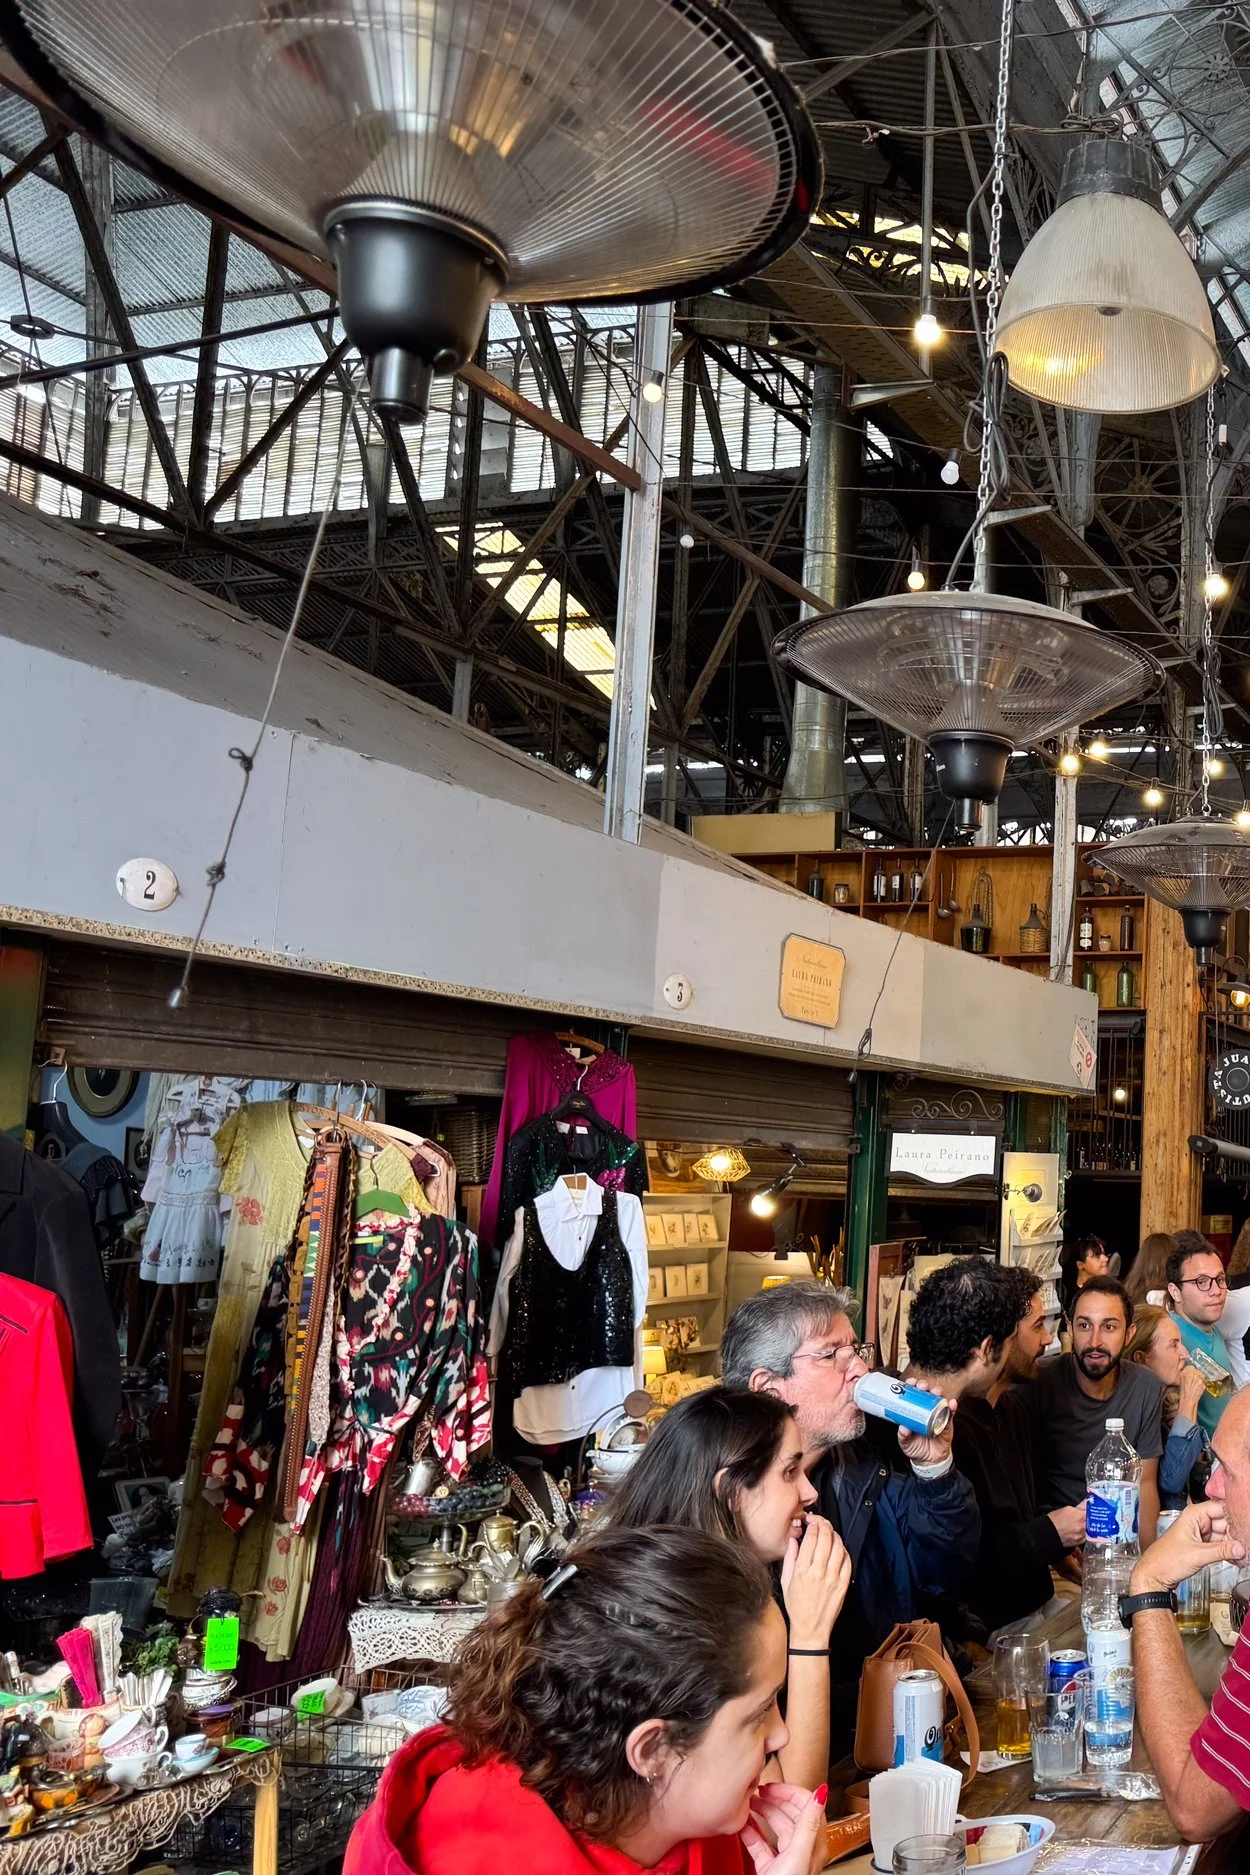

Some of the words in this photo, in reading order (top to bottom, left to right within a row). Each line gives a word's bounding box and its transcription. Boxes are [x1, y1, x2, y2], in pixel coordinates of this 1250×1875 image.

[144, 870, 156, 900] 2
[677, 982, 684, 1003] 3
[896, 1147, 931, 1159] Laura
[940, 1148, 989, 1161] Peirano
